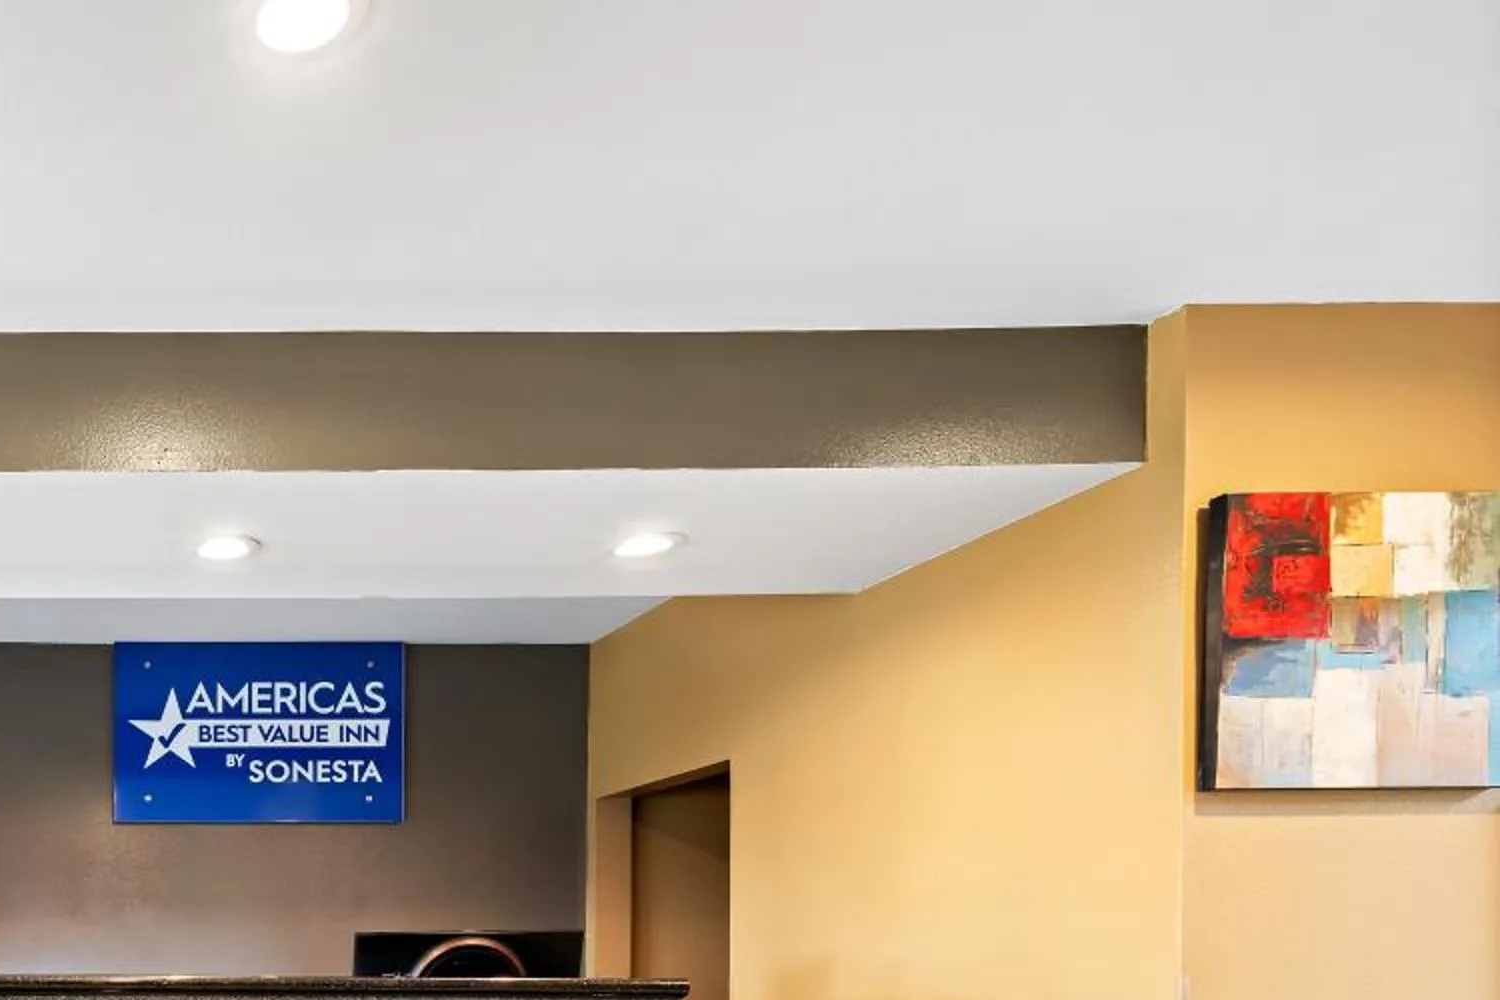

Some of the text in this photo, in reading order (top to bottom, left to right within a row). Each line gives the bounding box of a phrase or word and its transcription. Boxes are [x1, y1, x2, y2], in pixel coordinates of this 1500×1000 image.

[185, 681, 387, 714] AMERICAS
[199, 724, 380, 743] BEST VALUE INN
[225, 753, 383, 783] BY SONESTA
